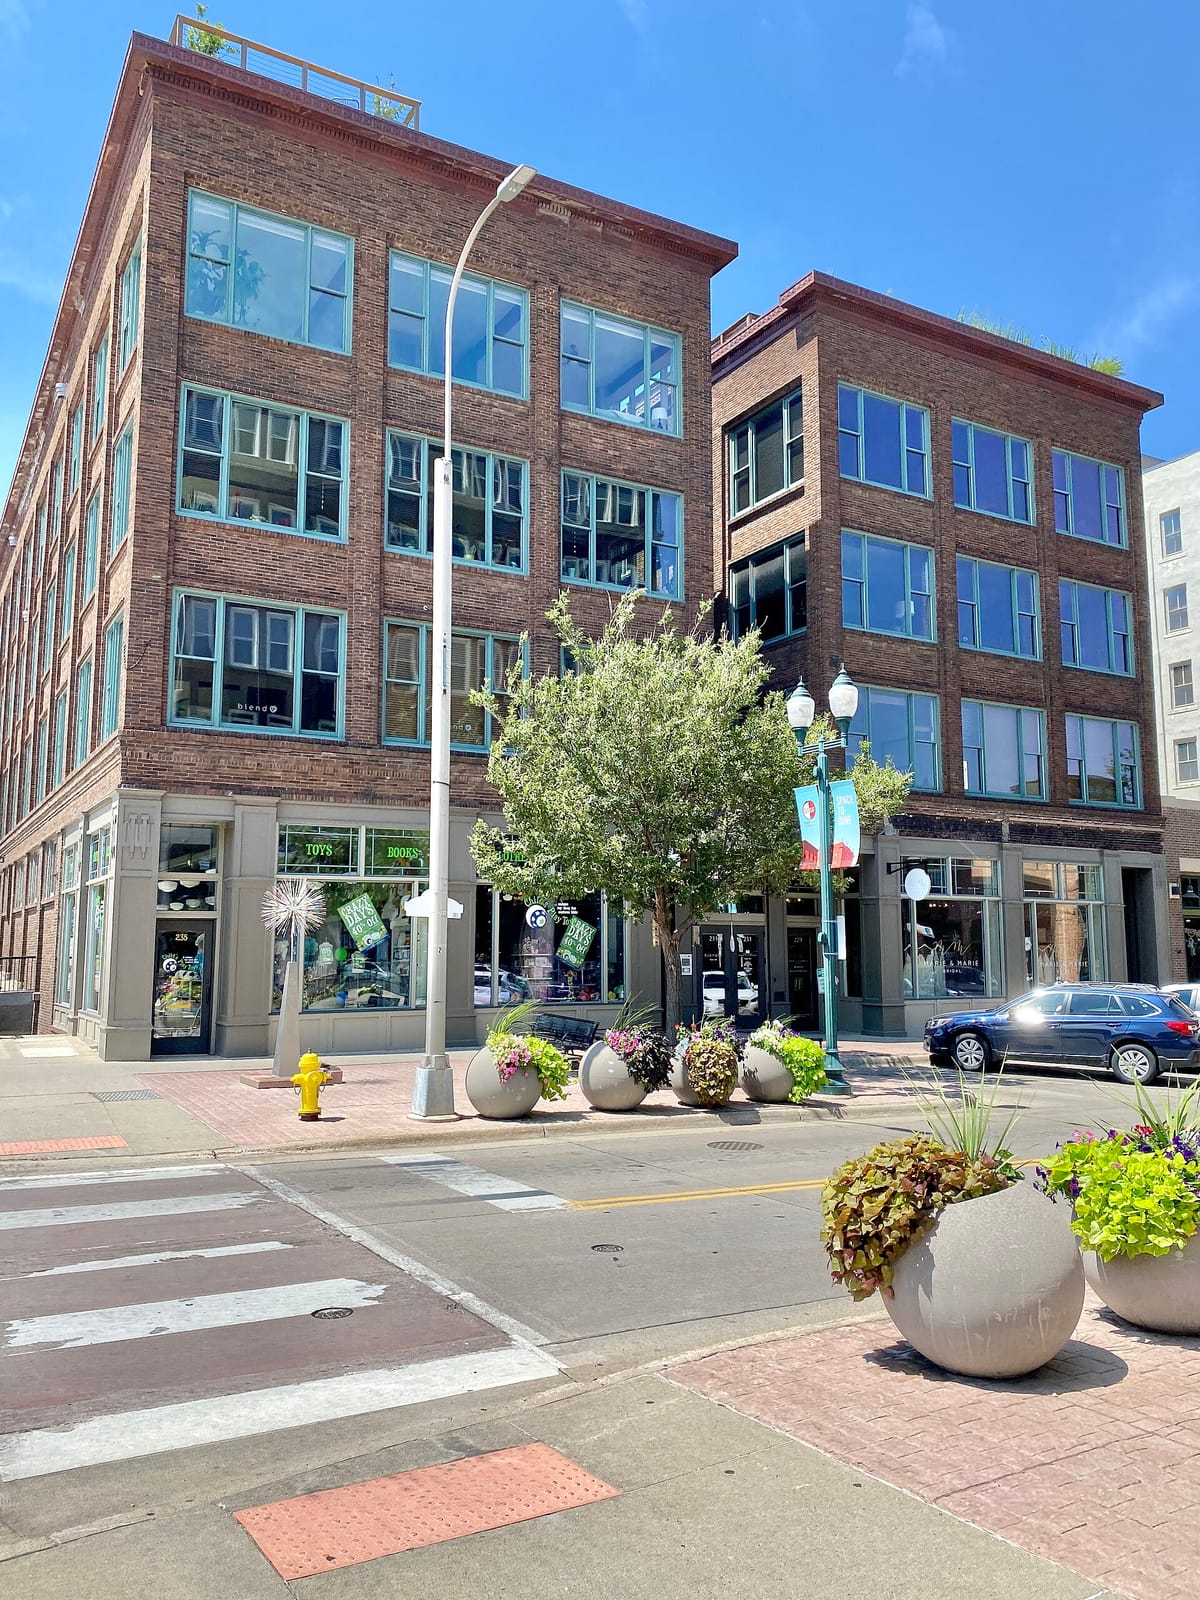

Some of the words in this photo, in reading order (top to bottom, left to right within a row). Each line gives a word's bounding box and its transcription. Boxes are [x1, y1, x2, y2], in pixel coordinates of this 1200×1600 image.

[237, 702, 268, 712] blend
[305, 843, 333, 857] TOYS
[387, 846, 419, 859] BOOKS
[341, 895, 369, 917] CRAZY
[345, 903, 374, 928] DAYS
[175, 933, 188, 941] 235
[568, 925, 592, 946] DAYS
